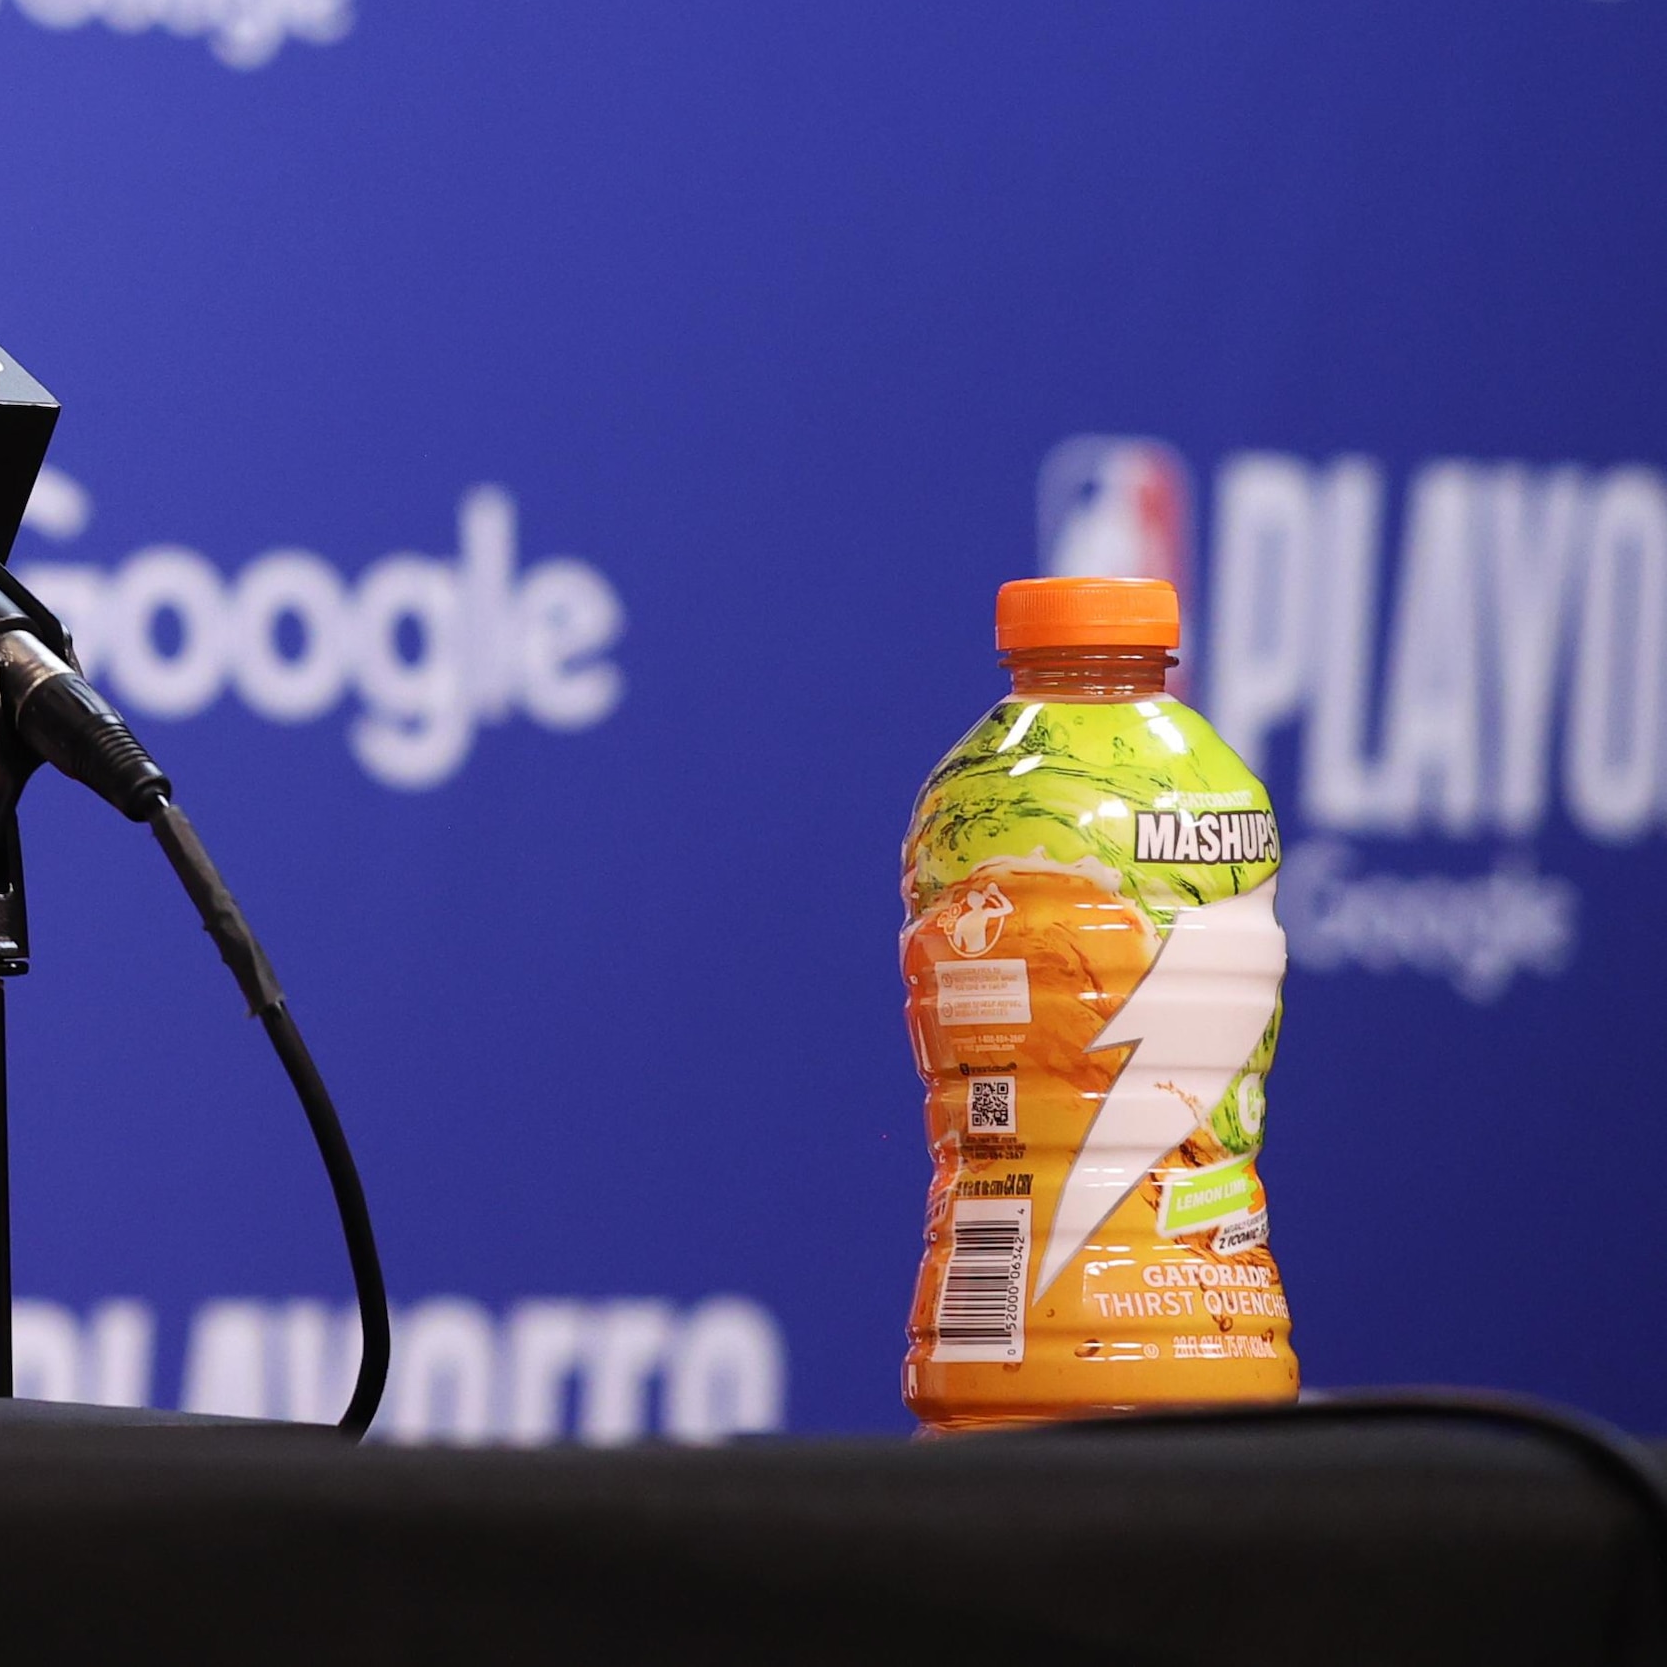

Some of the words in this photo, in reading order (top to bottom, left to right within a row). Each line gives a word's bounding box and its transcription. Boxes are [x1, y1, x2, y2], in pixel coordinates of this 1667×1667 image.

[1135, 812, 1279, 863] MASHUPS
[1017, 1208, 1026, 1216] 4
[1176, 1186, 1222, 1212] LEMON
[1011, 1235, 1026, 1280] 06342
[1143, 1264, 1271, 1289] GATORADE
[1006, 1286, 1020, 1331] 52000
[1093, 1290, 1194, 1319] THIRST
[1006, 1348, 1017, 1356] 0
